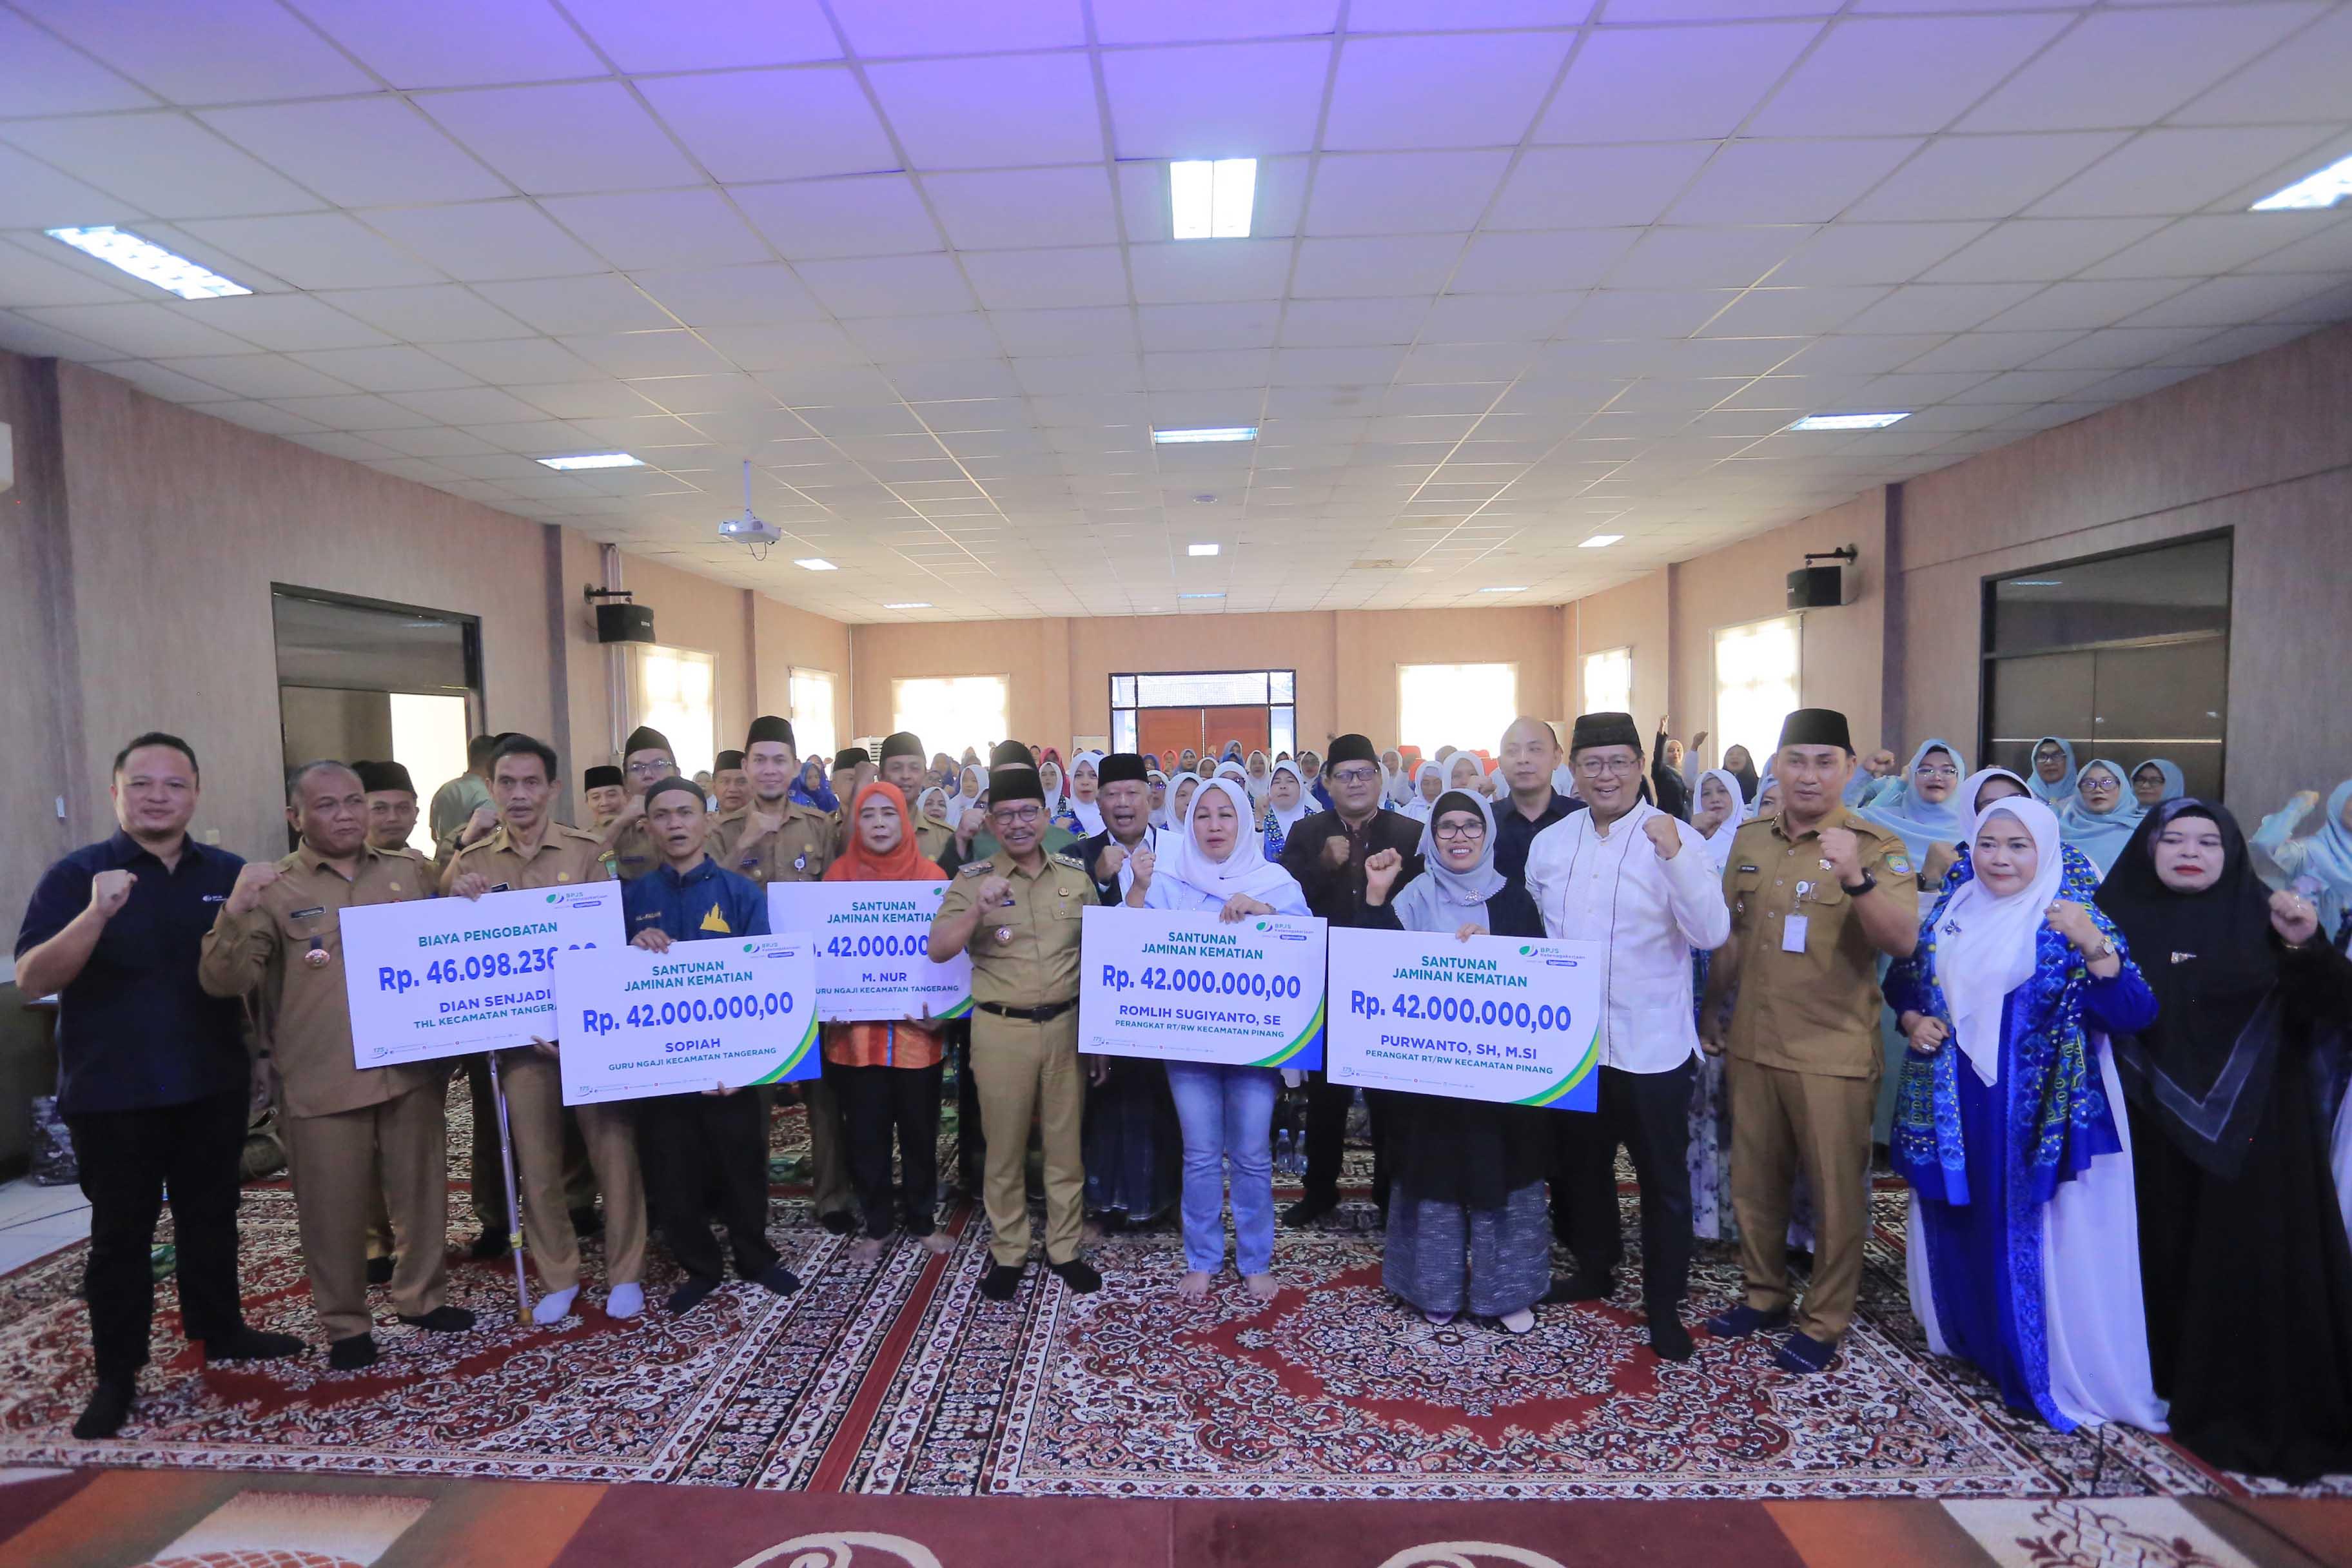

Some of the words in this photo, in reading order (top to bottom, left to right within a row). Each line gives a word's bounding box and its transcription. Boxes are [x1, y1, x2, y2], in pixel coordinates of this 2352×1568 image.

[852, 901, 916, 910] SANTUNAN
[827, 914, 879, 923] JAMINAN
[419, 933, 460, 946] BIAYA
[464, 923, 557, 941] PENGOBATAN
[1169, 932, 1236, 945] SANTUNAN
[828, 935, 928, 957] 42.000.00
[1142, 944, 1196, 956] JAMINAN
[1200, 946, 1262, 959] KEMATIAN
[379, 967, 419, 994] Rp.
[427, 943, 596, 984] 46.098.236
[652, 961, 723, 975] SANTUNAN
[1422, 956, 1496, 970] SANTUNAN
[625, 977, 683, 991] JAMINAN
[687, 971, 752, 986] KEMATIAN
[863, 974, 876, 982] M.
[880, 972, 906, 981] NUR
[1103, 965, 1134, 992] Rp.
[1141, 967, 1300, 1001] 42.000.000,00
[1393, 968, 1452, 981] JAMINAN
[1457, 972, 1527, 987] KEMATIAN
[440, 999, 479, 1013] DIAN
[485, 989, 551, 1006] SENJADI
[414, 1020, 436, 1028] THL
[439, 1010, 507, 1025] KECAMATAN
[511, 1004, 556, 1015] TANGER
[583, 1010, 619, 1035] Rp.
[627, 992, 793, 1027] 42.000.000,00
[1120, 1005, 1171, 1017] ROMLIH
[1176, 1009, 1259, 1026] SUGIYANTO,
[1264, 1015, 1280, 1025] SE
[1352, 990, 1385, 1019] Rp.
[1393, 994, 1571, 1034] 42.000.000,00
[1115, 1020, 1164, 1028] PERANGKAT
[1197, 1026, 1249, 1035] KECAMATAN
[665, 1038, 720, 1052] SOPIAH
[1382, 1035, 1471, 1055] PURWANTO,
[1476, 1044, 1500, 1057] SH,
[1506, 1046, 1536, 1059] M.SI
[637, 1059, 663, 1068] NGAJI
[666, 1054, 720, 1064] KECAMATAN
[723, 1048, 776, 1058] TANGERANG
[1366, 1050, 1418, 1061] PERANGKAT
[1422, 1055, 1452, 1064] RT/RW
[1455, 1059, 1513, 1070] KECAMATAN
[1516, 1064, 1553, 1074] PINANG
